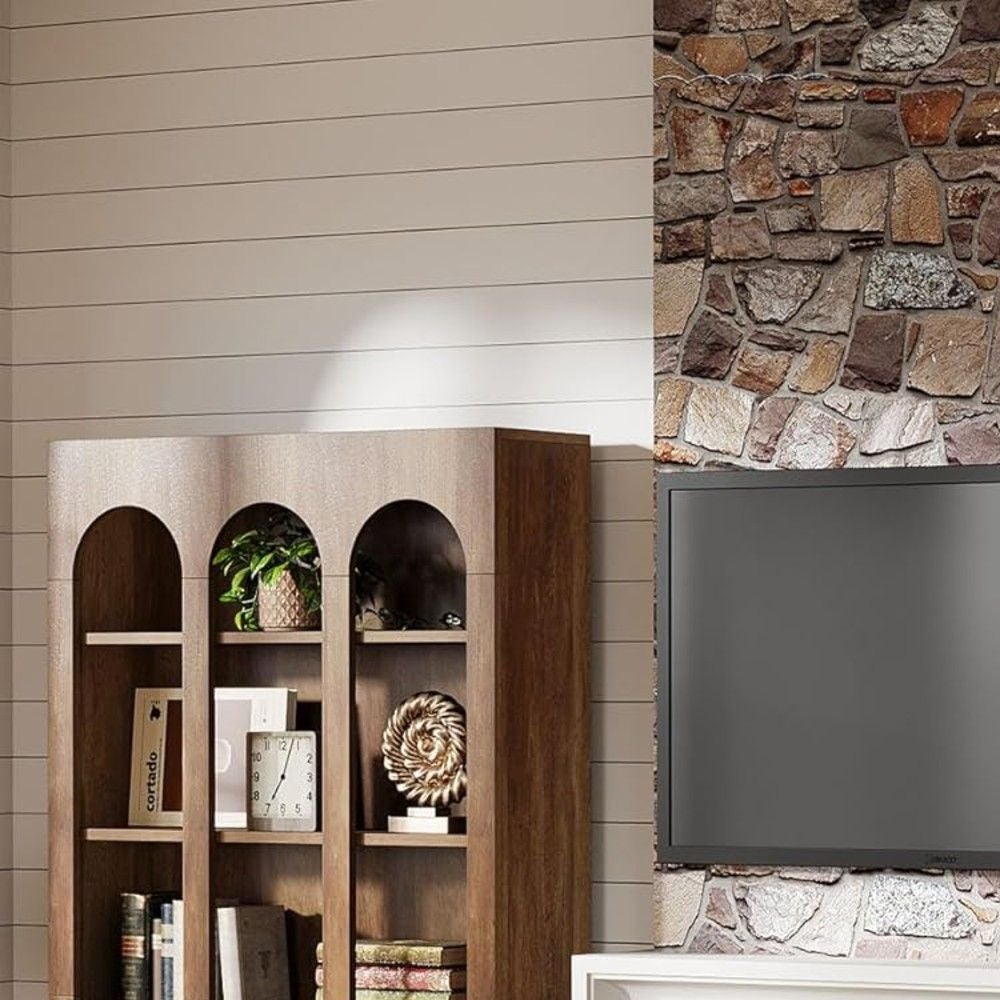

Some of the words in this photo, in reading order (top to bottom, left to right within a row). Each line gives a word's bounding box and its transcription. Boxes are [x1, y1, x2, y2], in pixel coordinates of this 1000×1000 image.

[306, 753, 313, 764] 2
[147, 751, 158, 813] cortado
[254, 771, 260, 782] 9
[306, 772, 313, 783] 3
[254, 790, 260, 801] 8
[306, 791, 312, 801] 4
[265, 803, 271, 813] 7
[280, 803, 286, 814] 6
[295, 803, 301, 814] 5
